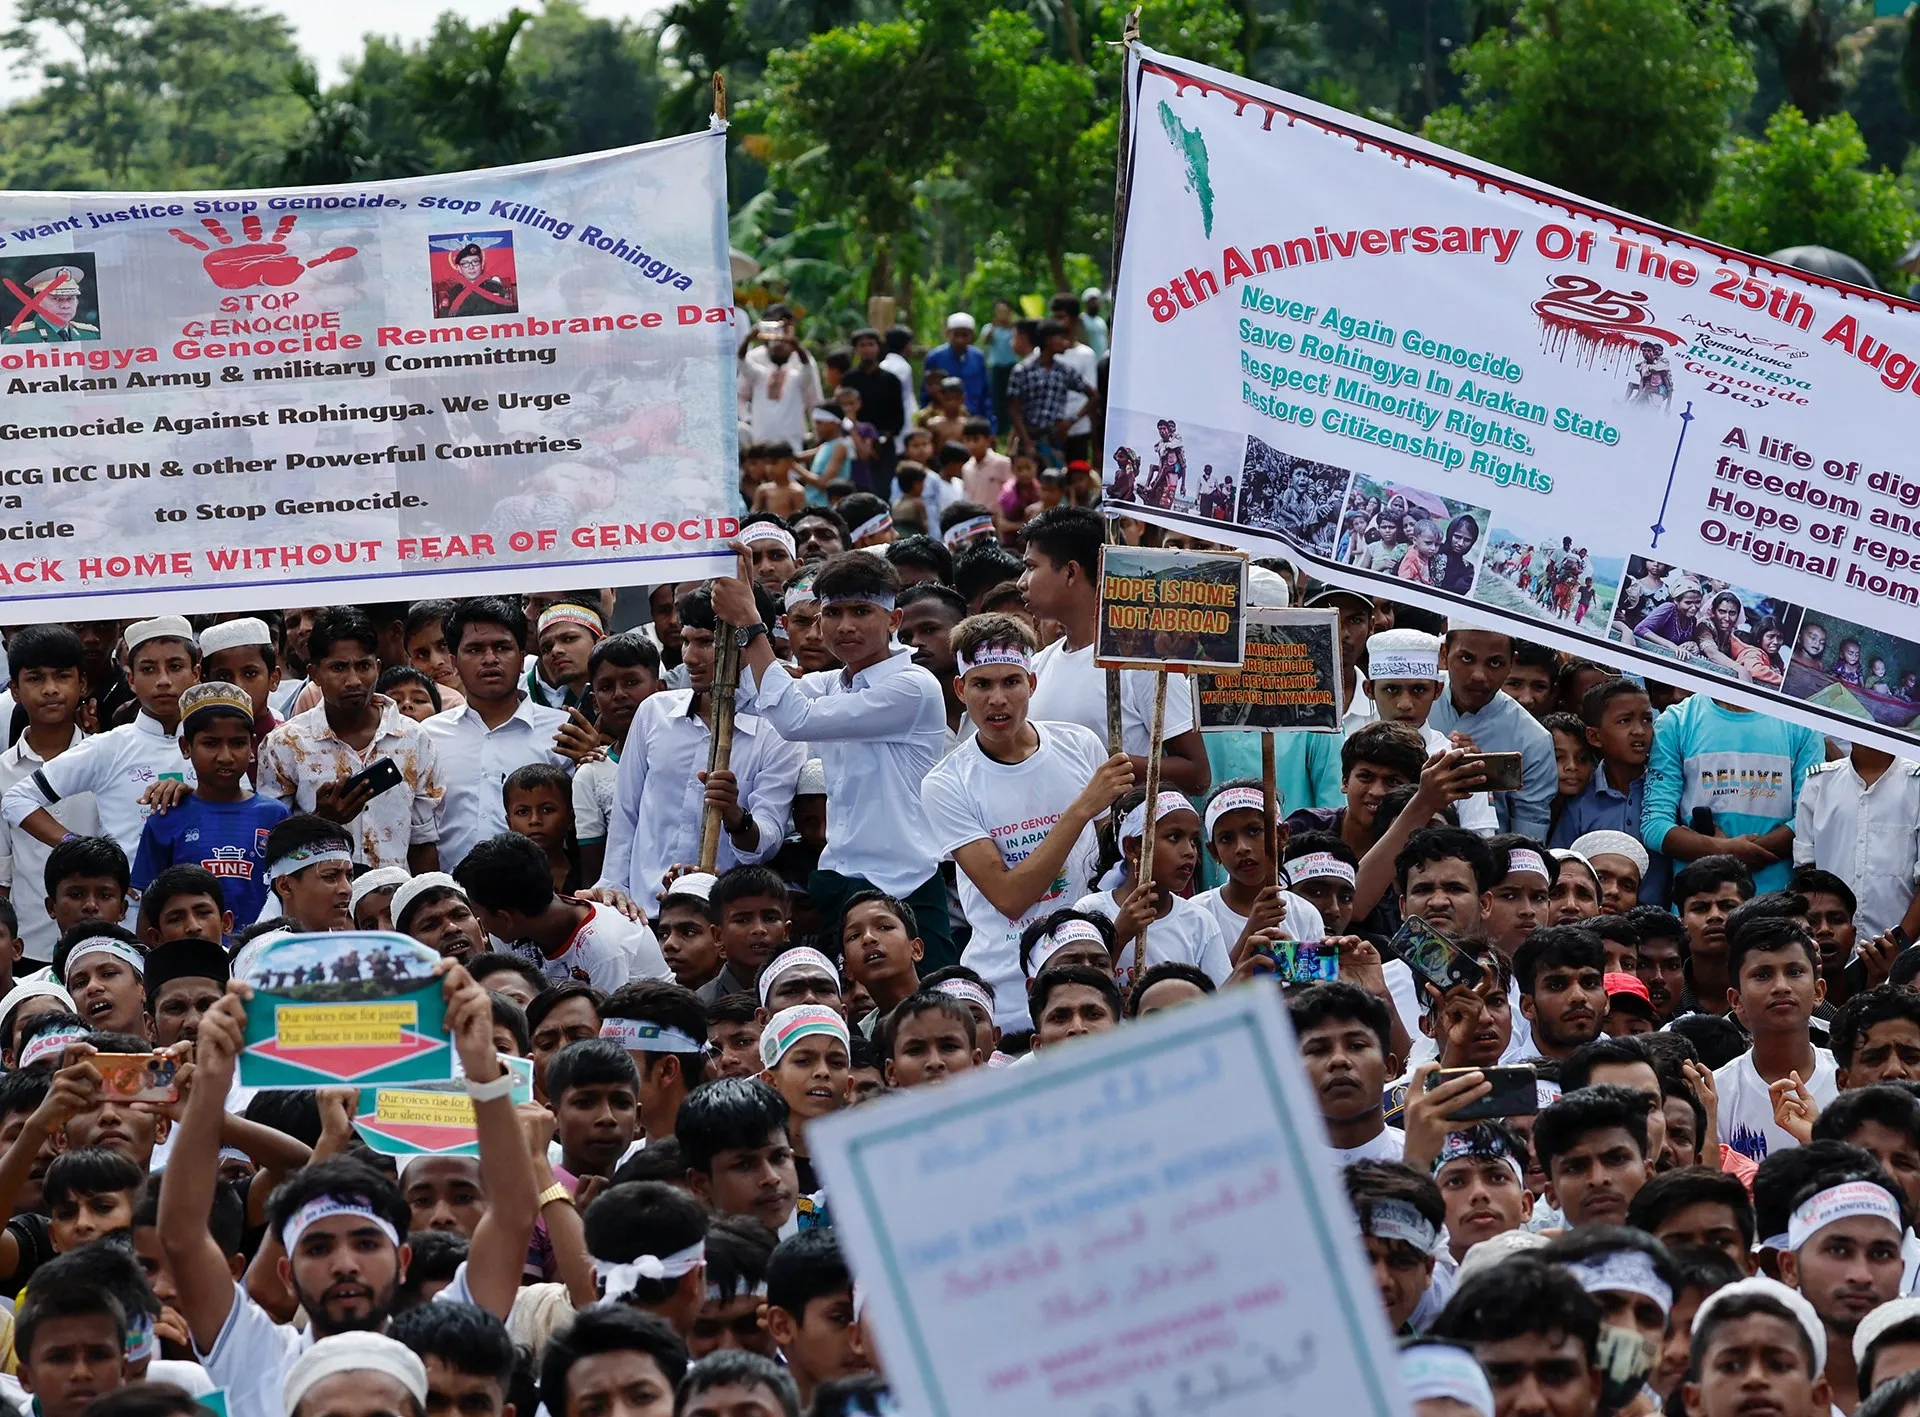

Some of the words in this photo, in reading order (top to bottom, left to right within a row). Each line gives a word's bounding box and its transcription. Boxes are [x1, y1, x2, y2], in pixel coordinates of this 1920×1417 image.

[11, 216, 82, 240] want
[90, 203, 184, 229] justice
[193, 199, 258, 217] Stop
[268, 194, 407, 210] Genocide,
[418, 196, 481, 214] Stop
[489, 200, 575, 240] Killing
[578, 224, 693, 292] Rohingya
[1146, 267, 1219, 325] 8th
[1221, 225, 1522, 288] Anniversary
[1535, 224, 1597, 264] Of
[1608, 235, 1699, 287] The
[1709, 267, 1815, 331] 25th
[219, 291, 300, 315] STOP
[0, 345, 158, 371] ohingya
[172, 331, 363, 361] Genocide
[376, 310, 664, 347] Remembrance
[182, 312, 341, 339] GENOCIDE
[1240, 284, 1319, 323] Never
[1320, 306, 1397, 350] Again
[1401, 330, 1523, 384] Genocide
[1695, 332, 1793, 370] Remembrance
[6, 373, 118, 395] Arakan
[126, 369, 211, 389] Army
[219, 365, 245, 382] &
[253, 358, 376, 381] military
[384, 347, 557, 372] Committng
[1238, 317, 1294, 352] Save
[1299, 333, 1420, 389] Rohingya
[1425, 369, 1453, 397] In
[1455, 380, 1549, 426] Arakan
[1552, 405, 1621, 446] State
[1687, 344, 1813, 391] Rohingya
[1684, 361, 1810, 407] Genocide
[1703, 381, 1769, 409] Day
[1, 416, 145, 440] Genocide
[152, 411, 270, 435] Against
[277, 402, 435, 422] Rohingya.
[441, 396, 490, 413] We
[498, 391, 572, 412] Urge
[1240, 349, 1330, 398] Respect
[1333, 375, 1442, 431] Minority
[1444, 407, 1536, 456] Rights.
[1241, 381, 1316, 427] Restore
[1320, 407, 1465, 471] Citizenship
[1468, 450, 1555, 495] Rights
[52, 464, 98, 483] ICC
[106, 462, 151, 481] UN
[159, 460, 184, 478] &
[192, 456, 278, 477] other
[285, 443, 426, 470] Powerful
[434, 435, 583, 460] Countries
[1721, 426, 1750, 453] A
[1757, 435, 1814, 470] life
[1822, 459, 1861, 484] of
[1866, 471, 1920, 507] dig
[1714, 456, 1862, 519] freedom
[154, 506, 188, 523] to
[196, 501, 266, 522] Stop
[274, 492, 429, 516] Genocide.
[1706, 486, 1801, 534] Hope
[1809, 522, 1847, 548] of
[78, 552, 194, 586] HOME
[205, 540, 382, 573] WITHOUT
[396, 531, 497, 563] FEAR
[508, 529, 558, 554] OF
[571, 515, 739, 551] GENOCID
[1699, 519, 1840, 581] Original
[1104, 576, 1156, 602] HOPE
[1181, 581, 1235, 607] HOME
[1109, 605, 1149, 629] NOT
[1149, 608, 1229, 634] ABROAD
[1245, 642, 1308, 657] MMIGRATION
[1215, 675, 1240, 688] ONLY
[1242, 675, 1317, 689] REPATRIATION
[1263, 660, 1314, 673] GENOCIDE
[1201, 690, 1229, 704] WITH
[1229, 690, 1264, 705] PEACE
[1264, 691, 1275, 705] IN
[1276, 691, 1336, 706] MYANMAR.
[1702, 769, 1783, 790] DELUXE
[990, 824, 1018, 838] STOP
[1006, 839, 1019, 849] IN
[208, 862, 249, 875] TINE
[1005, 850, 1030, 862] 25th
[278, 1009, 301, 1023] Our
[304, 1011, 335, 1022] voices
[339, 1010, 356, 1020] rise
[360, 1008, 375, 1020] for
[378, 1009, 412, 1022] justice
[608, 1019, 624, 1027] STOP
[278, 1030, 301, 1043] Our
[304, 1028, 338, 1042] silence
[342, 1029, 351, 1040] is
[354, 1031, 369, 1040] no
[371, 1031, 400, 1040] more
[378, 1092, 399, 1104] Our
[401, 1095, 429, 1105] voices
[432, 1096, 448, 1106] rise
[451, 1095, 464, 1107] for
[377, 1109, 397, 1120] Our
[400, 1109, 431, 1122] silence
[434, 1110, 442, 1122] is
[444, 1114, 457, 1123] no
